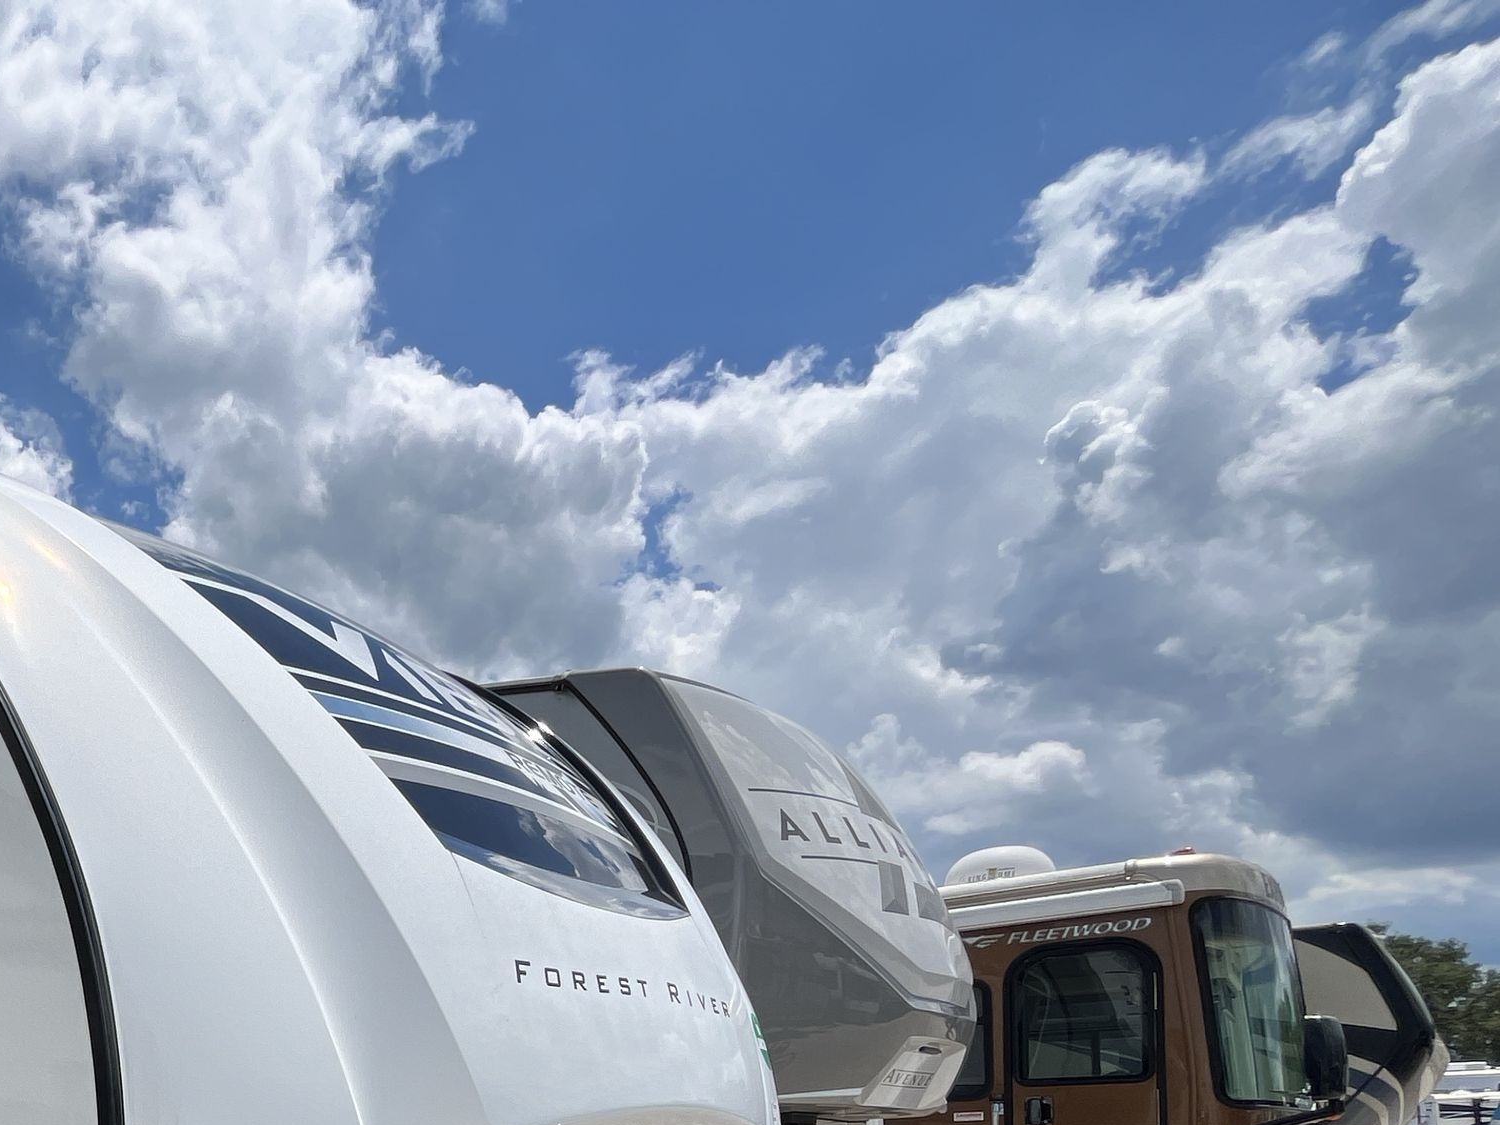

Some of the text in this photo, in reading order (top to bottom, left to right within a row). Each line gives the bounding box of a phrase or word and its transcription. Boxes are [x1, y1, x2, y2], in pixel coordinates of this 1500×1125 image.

[780, 808, 925, 868] ALLIA
[1007, 917, 1151, 945] FLEETWOOD
[514, 959, 731, 1018] FOREST RIVER
